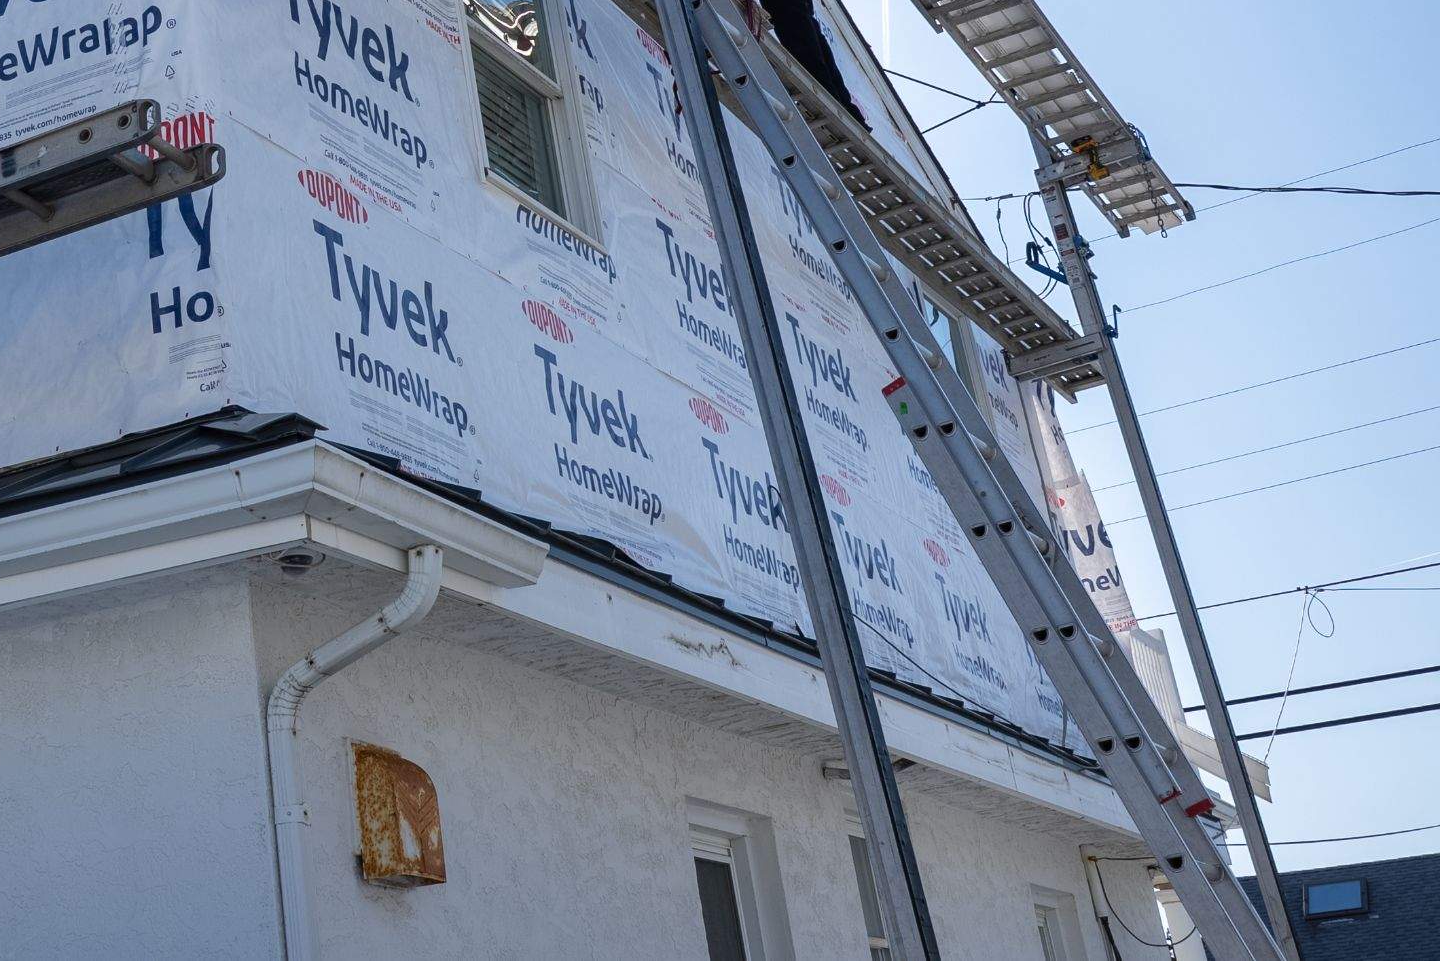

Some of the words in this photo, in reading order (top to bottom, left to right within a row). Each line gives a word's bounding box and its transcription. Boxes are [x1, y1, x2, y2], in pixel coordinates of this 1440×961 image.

[15, 105, 97, 137] tyvek.com/homewrap
[137, 111, 215, 159] PONT
[294, 50, 427, 169] HomeWrap
[298, 170, 368, 224] DUPONT
[150, 286, 215, 334] Ho
[312, 218, 456, 364] Tyvek
[522, 300, 573, 343] DUPONT
[335, 331, 468, 438] HomeWrap
[785, 312, 857, 402] Tyvek
[533, 343, 650, 460] Tyvek
[804, 384, 867, 453] HomeWrap
[554, 443, 662, 525] HomeWrap
[831, 510, 902, 595] Tyvek
